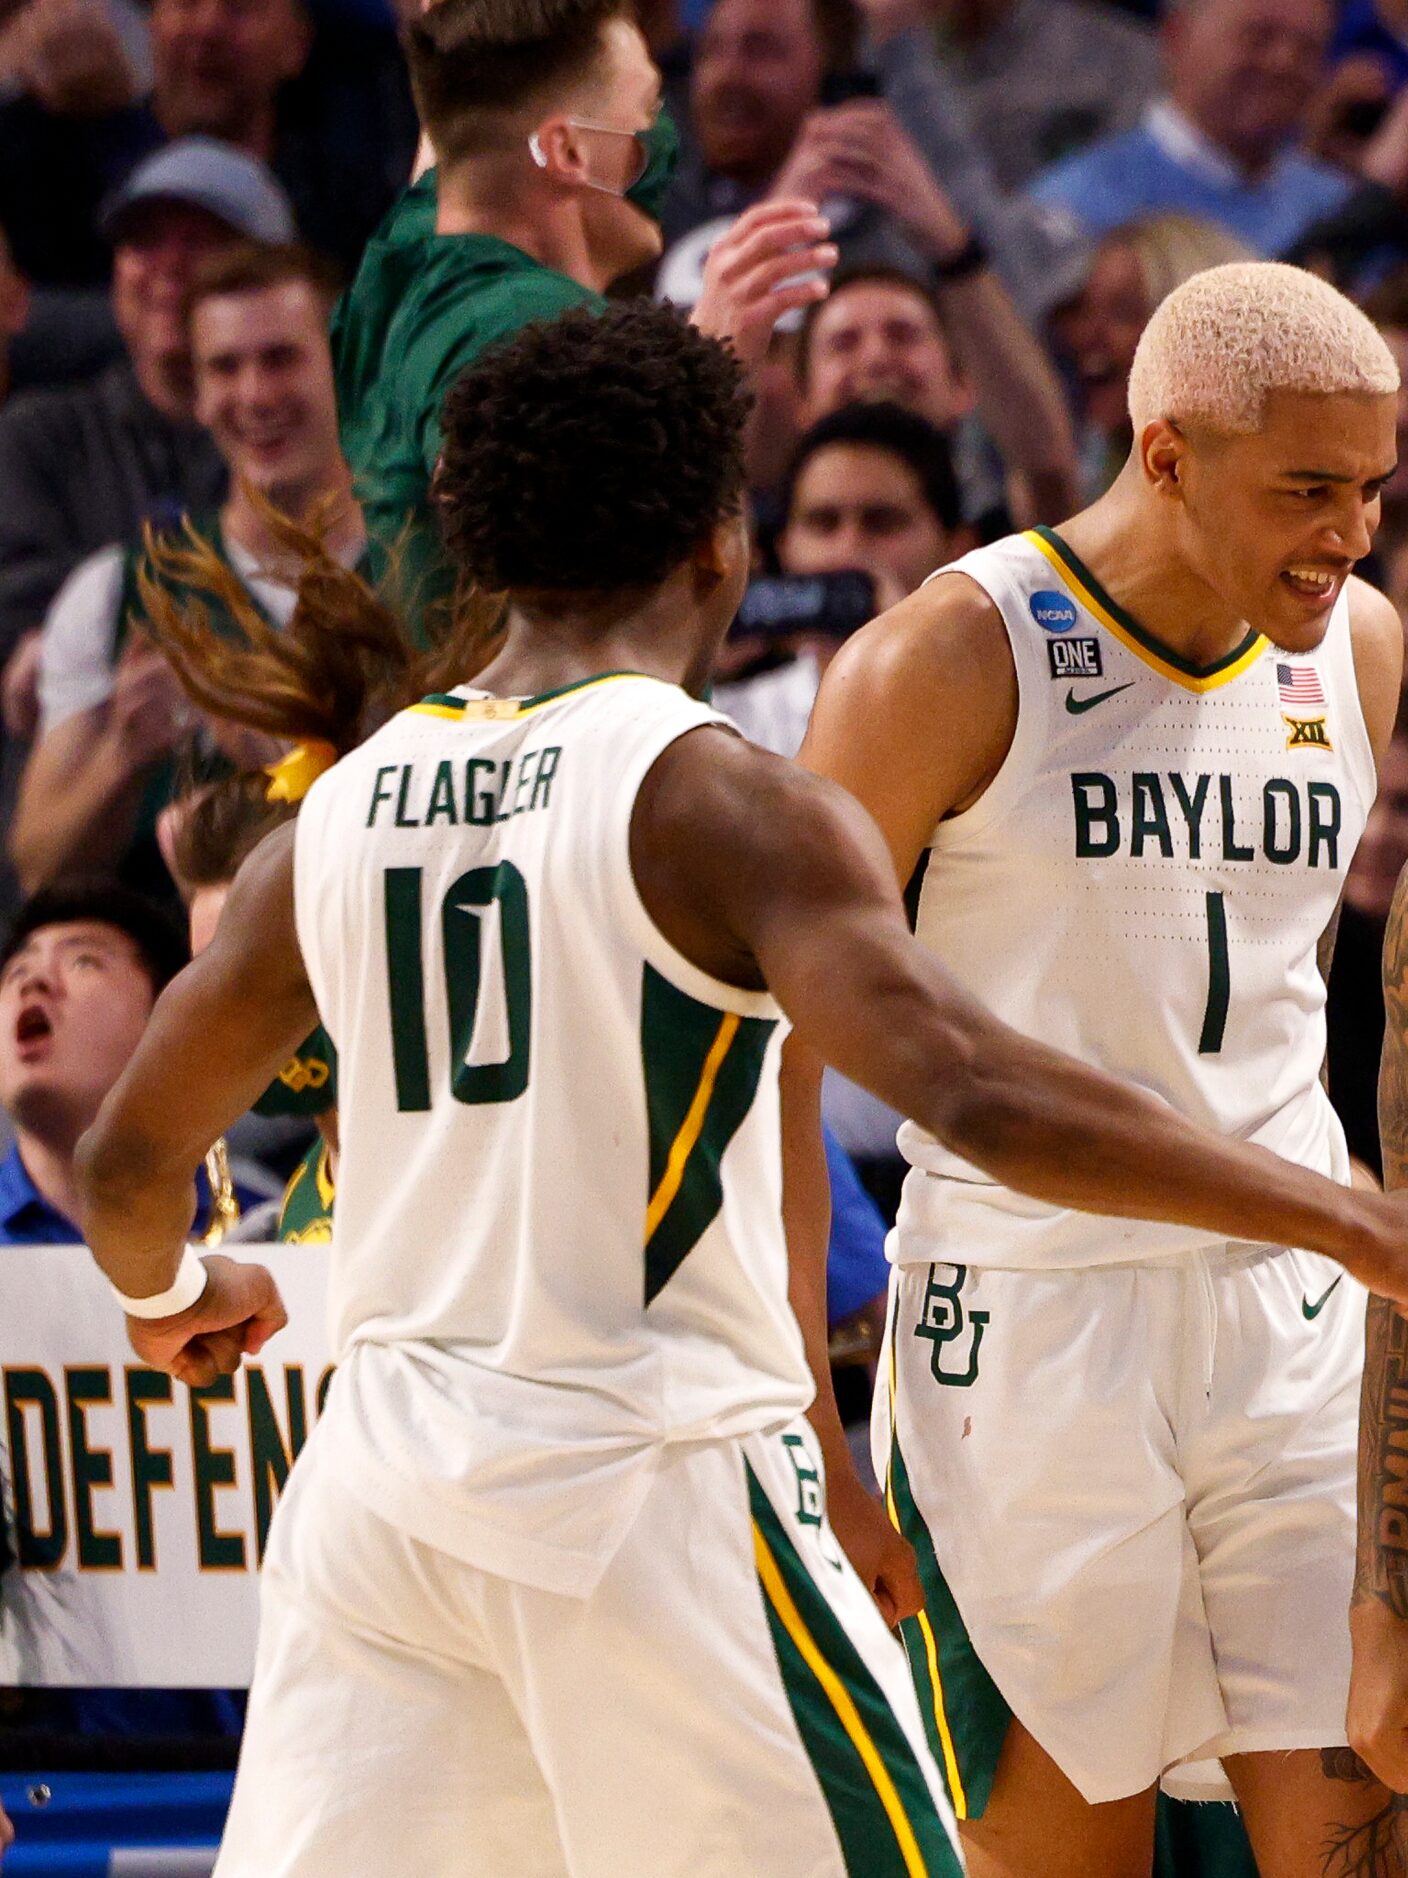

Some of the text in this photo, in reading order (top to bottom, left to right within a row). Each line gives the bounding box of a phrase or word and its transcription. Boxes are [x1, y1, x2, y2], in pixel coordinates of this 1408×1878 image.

[1053, 641, 1097, 668] ONE
[365, 746, 563, 828] FLAGLER
[1071, 772, 1341, 869] BAYLOR
[384, 859, 532, 1112] 10
[1197, 891, 1230, 1054] 1
[2, 1364, 338, 1573] DEFEN
